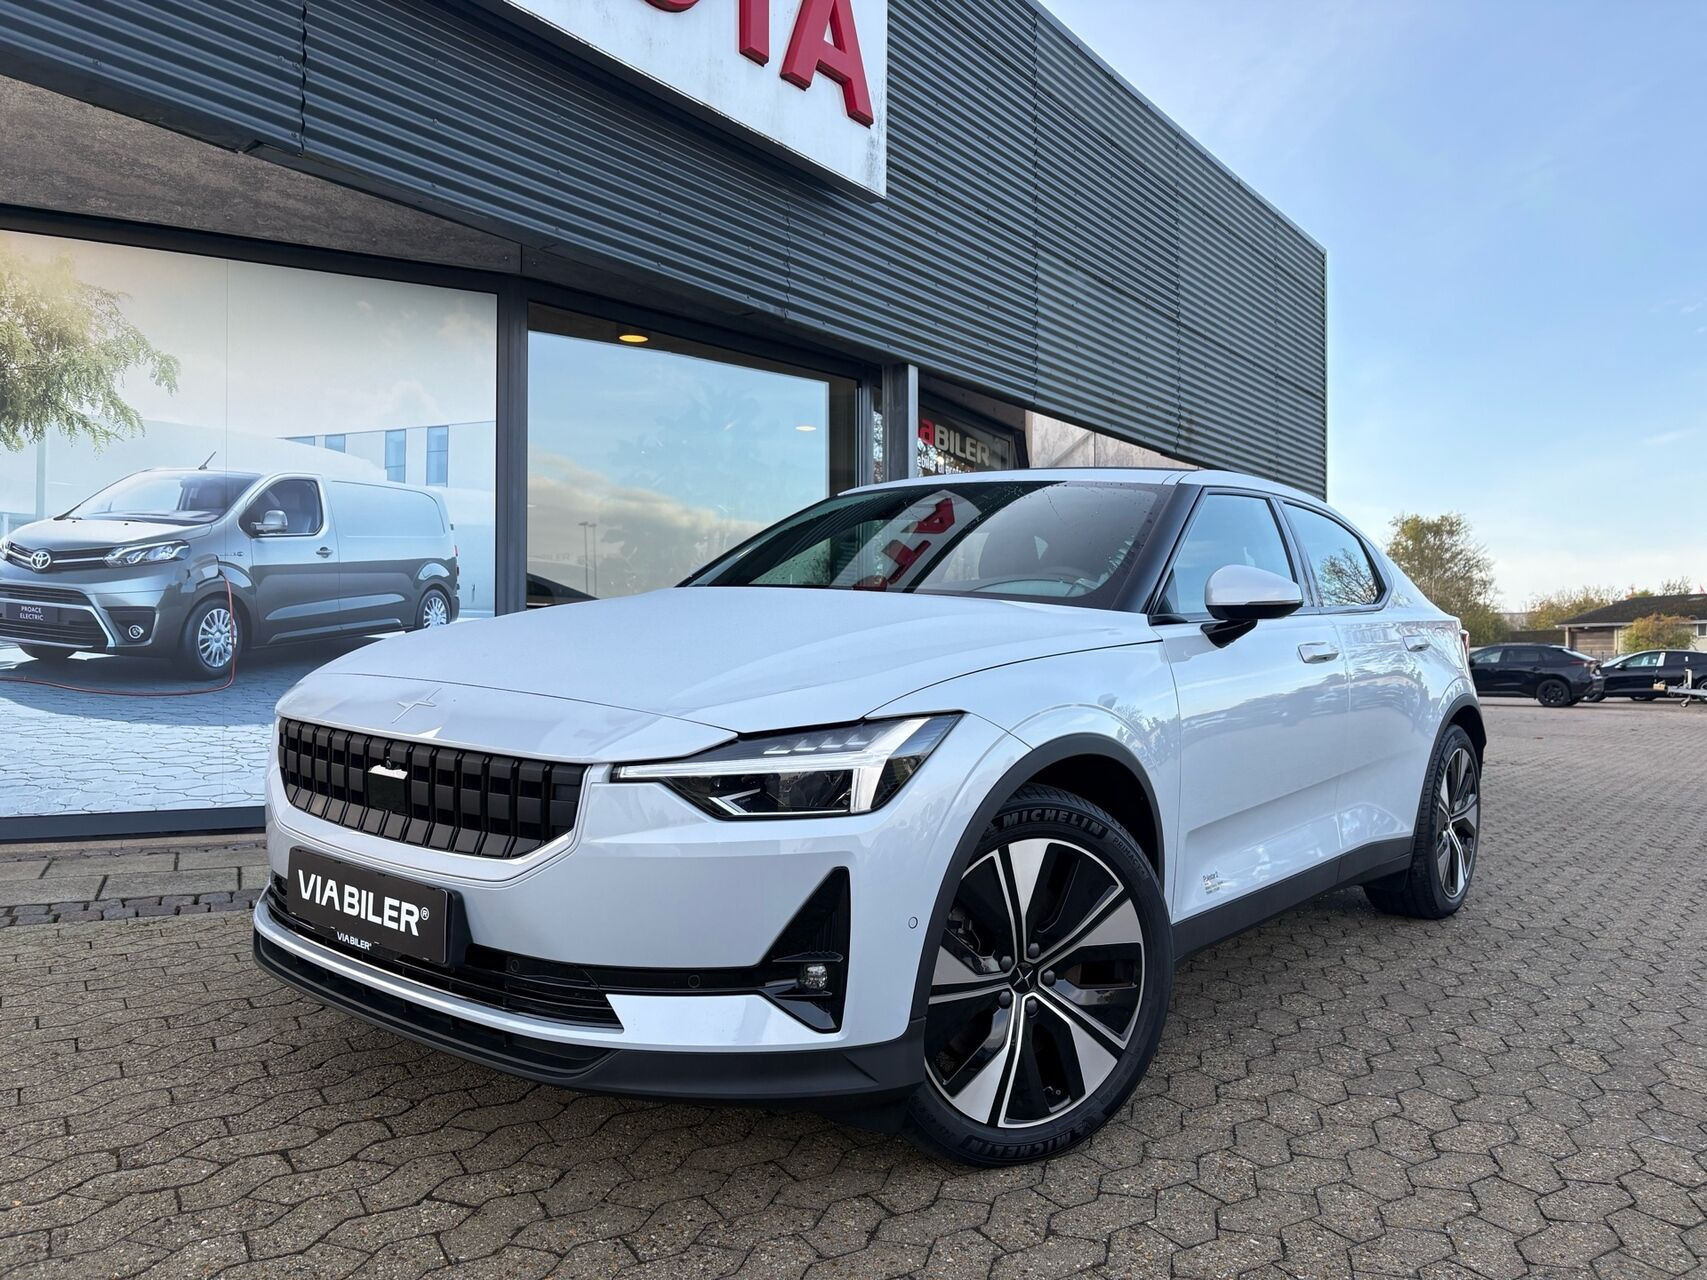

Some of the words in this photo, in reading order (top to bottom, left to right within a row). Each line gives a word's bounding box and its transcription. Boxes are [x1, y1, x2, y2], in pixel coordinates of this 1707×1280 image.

[21, 606, 42, 614] PROACE
[19, 612, 44, 621] ELECTRIC
[1003, 809, 1104, 836] MICHELIN
